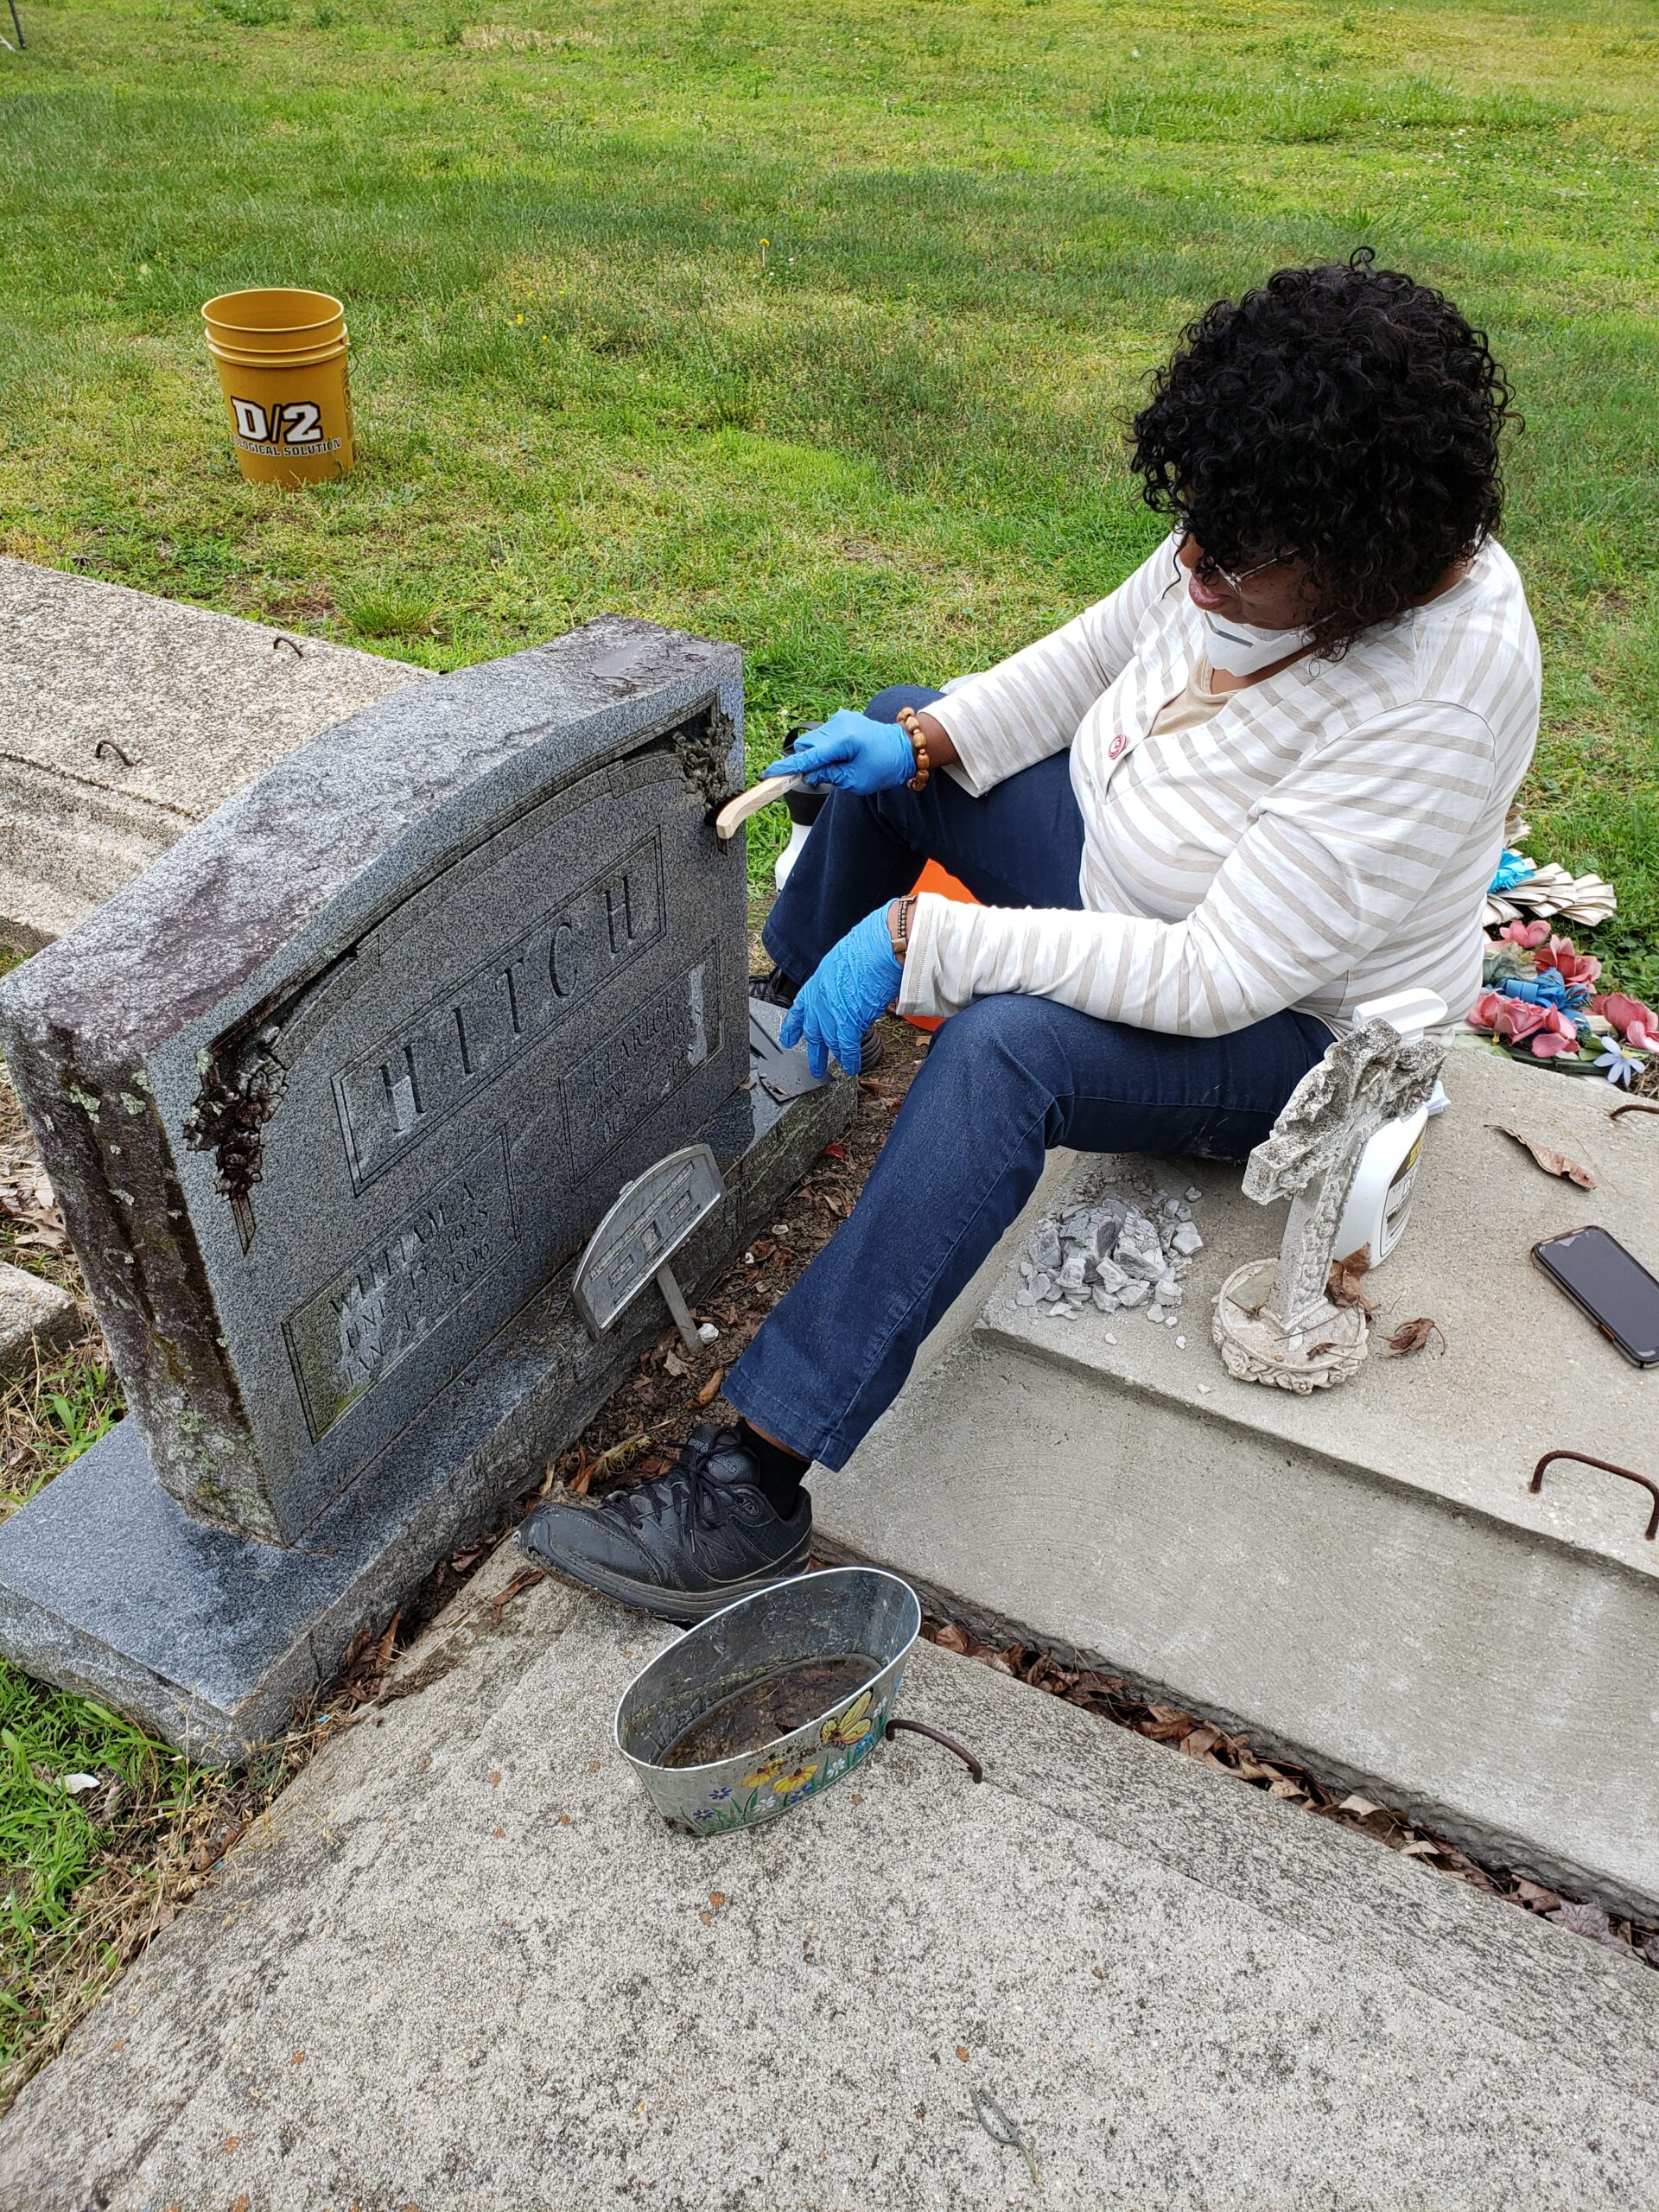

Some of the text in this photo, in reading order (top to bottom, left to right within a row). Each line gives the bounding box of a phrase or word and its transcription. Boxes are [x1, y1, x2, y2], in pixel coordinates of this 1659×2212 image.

[230, 395, 324, 445] D/2
[283, 436, 341, 457] SOLUTION
[378, 872, 637, 1133] HITCH
[328, 1201, 448, 1320] WILLIAM
[345, 1338, 385, 1389] JAN
